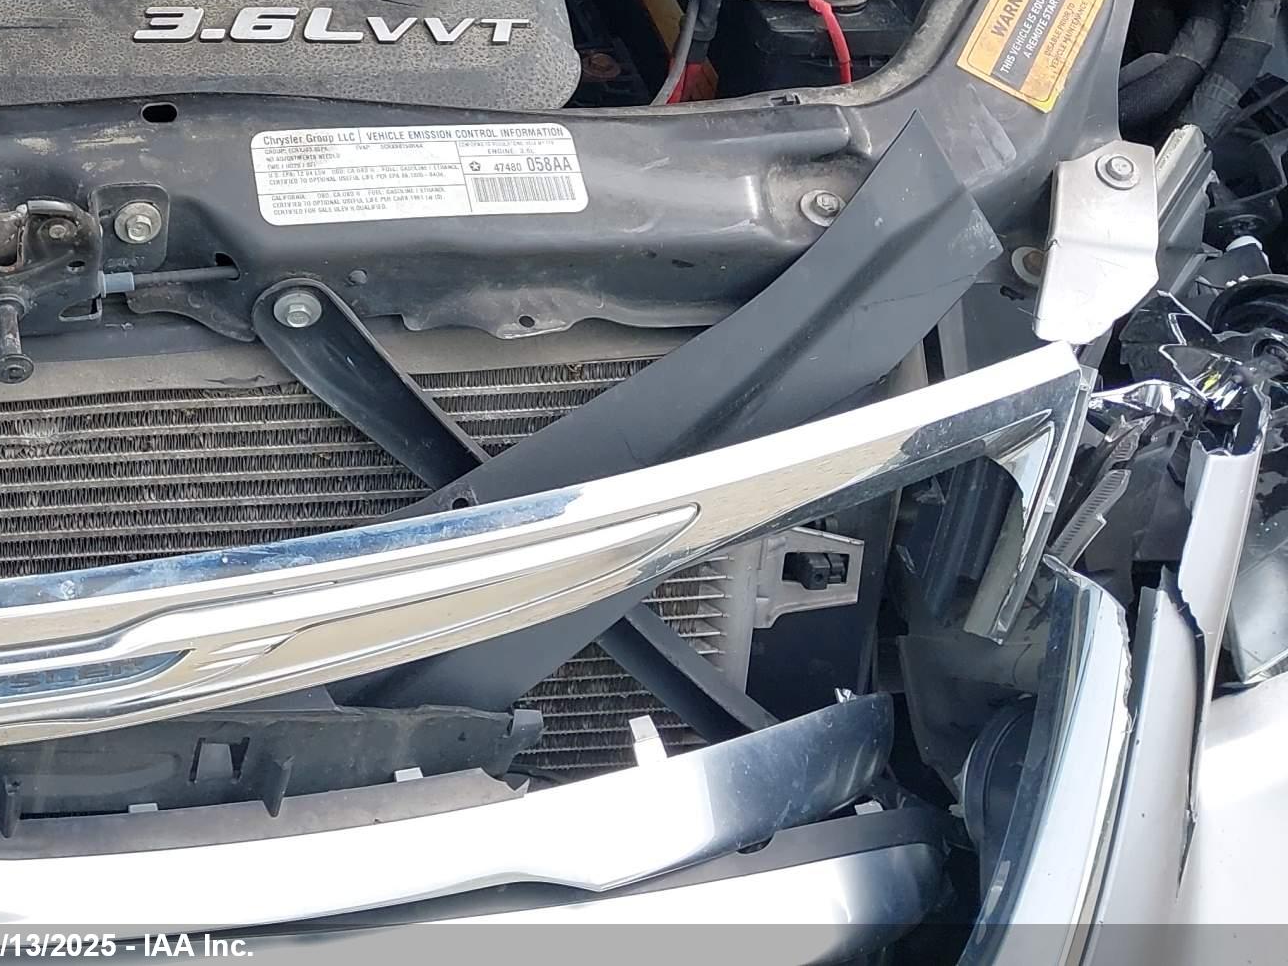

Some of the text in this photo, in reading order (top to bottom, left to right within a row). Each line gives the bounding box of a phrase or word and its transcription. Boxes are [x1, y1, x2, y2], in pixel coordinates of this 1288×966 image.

[133, 6, 530, 45] 3.6L VVT
[1026, 18, 1049, 50] REMOTE
[1000, 54, 1016, 74] THIS
[1009, 20, 1032, 56] VEHICLE
[1027, 12, 1037, 25] IS
[1023, 50, 1032, 59] A
[263, 132, 355, 146] Chrysler Group LLC
[366, 127, 564, 141] VEHICLE EMISSION CONTROL INFORMATION
[526, 156, 572, 172] 058AA
